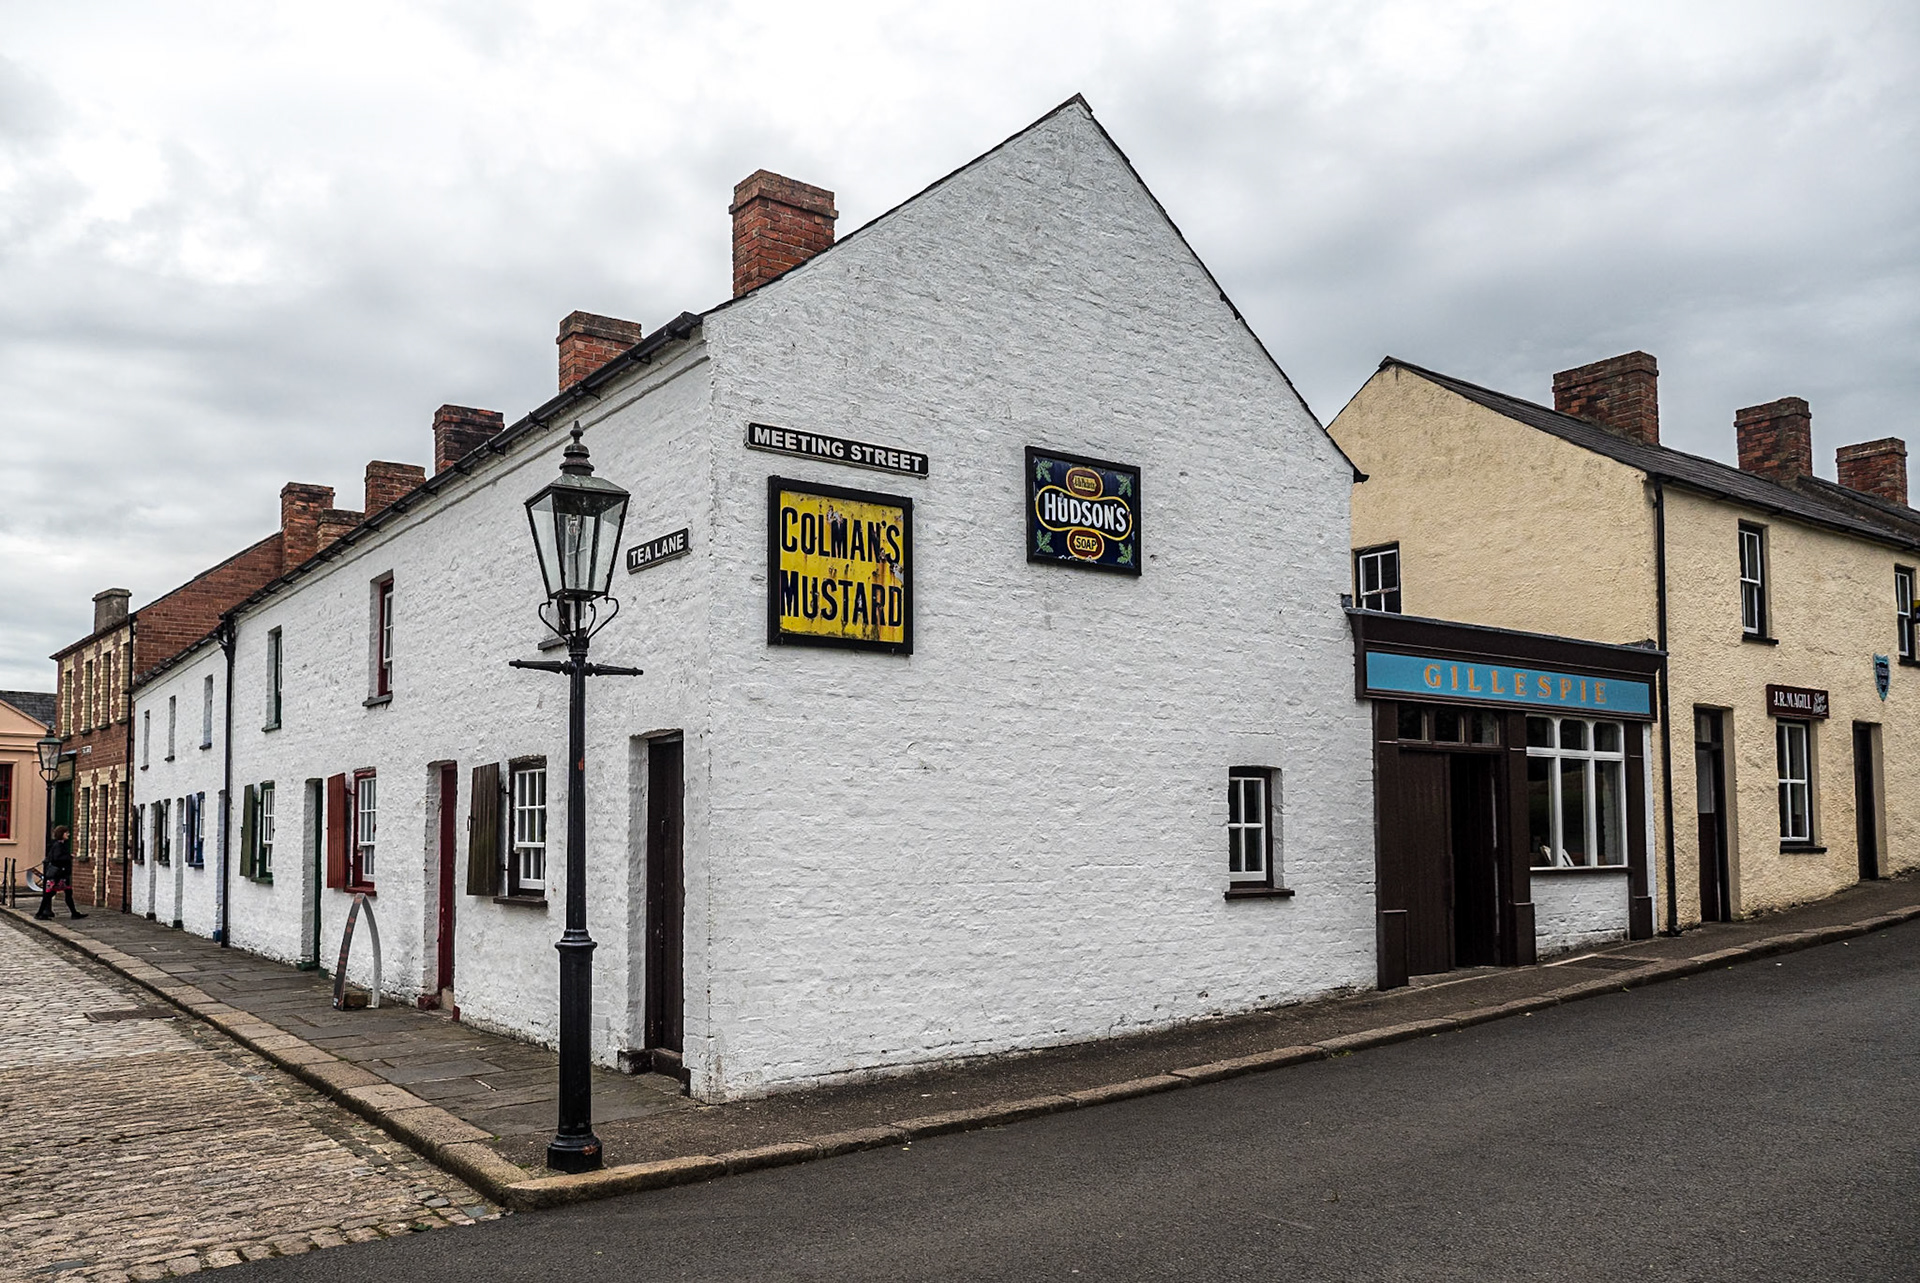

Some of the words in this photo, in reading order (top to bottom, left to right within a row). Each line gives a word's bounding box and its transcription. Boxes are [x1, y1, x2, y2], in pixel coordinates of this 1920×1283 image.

[754, 426, 845, 458] MEETING
[850, 444, 923, 472] STREET
[1044, 492, 1127, 532] HUDSON'S
[631, 545, 652, 566] TEA
[655, 533, 684, 558] LANE
[781, 506, 900, 564] COLMAN'S
[1075, 537, 1097, 550] SOAP
[779, 570, 902, 628] MUSTARD
[1423, 663, 1606, 704] GILLESPIE
